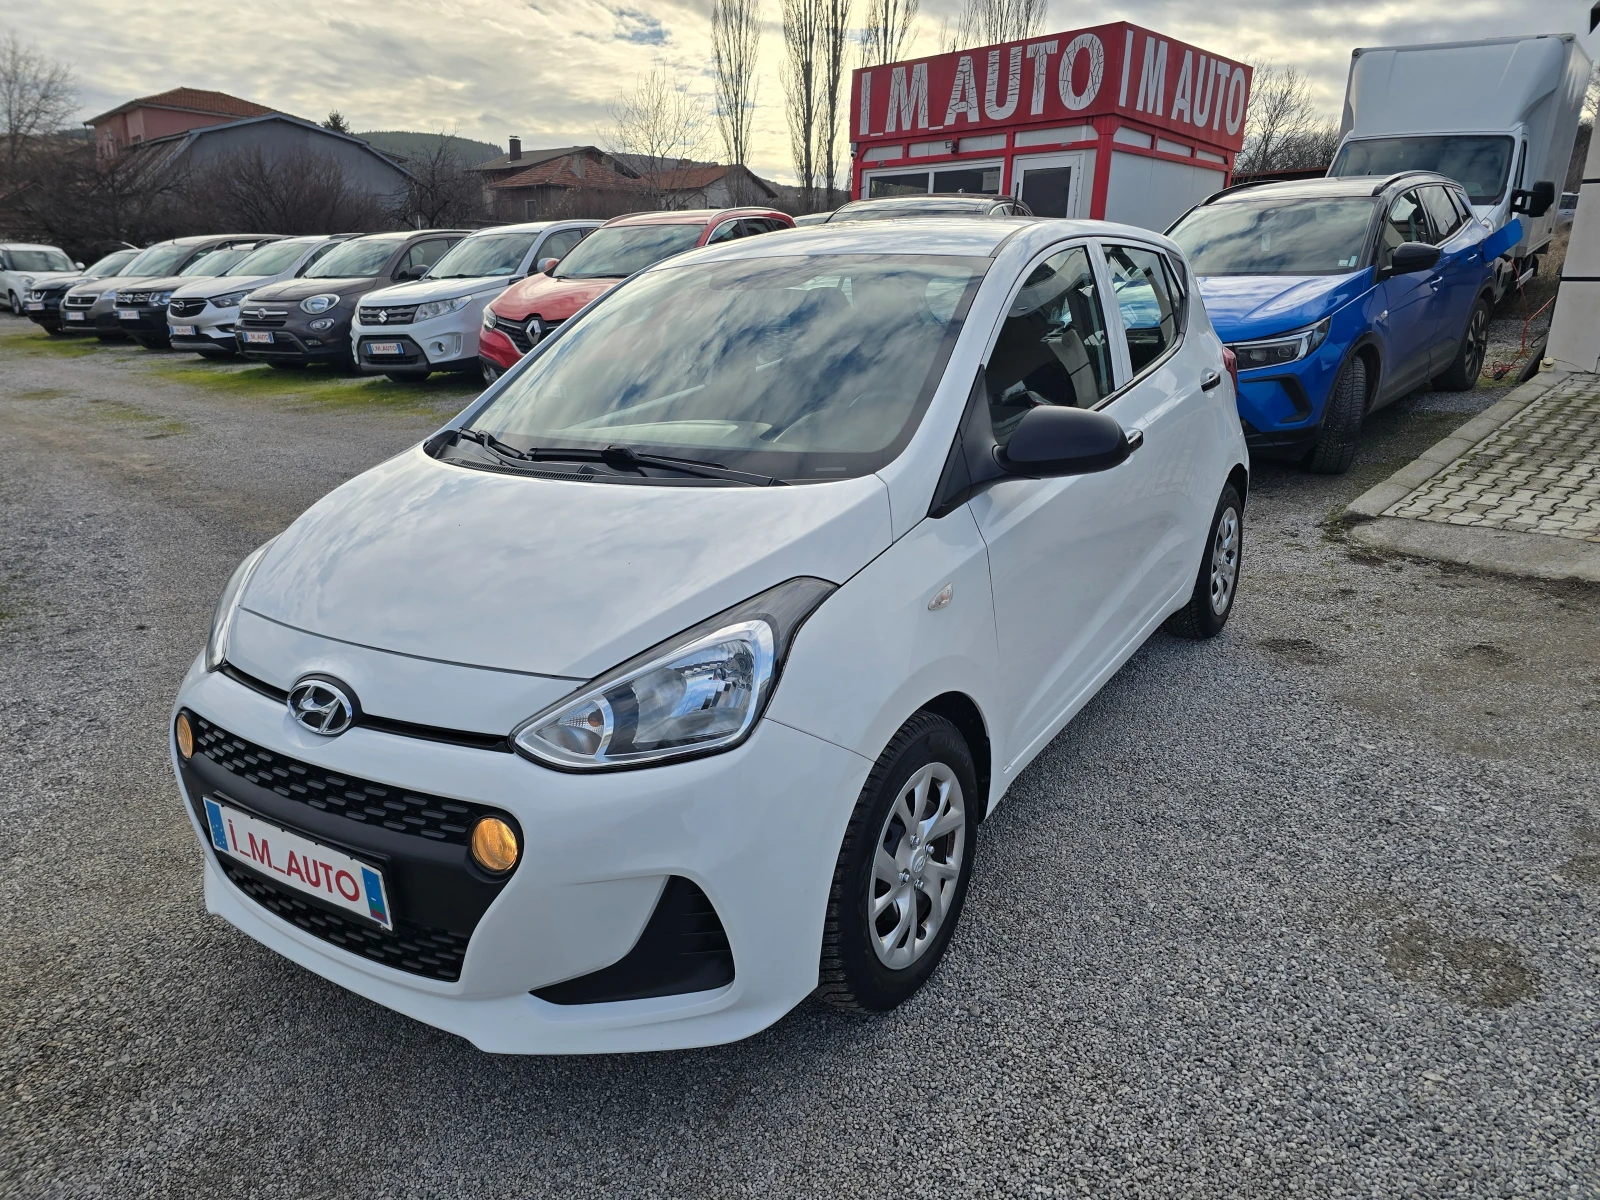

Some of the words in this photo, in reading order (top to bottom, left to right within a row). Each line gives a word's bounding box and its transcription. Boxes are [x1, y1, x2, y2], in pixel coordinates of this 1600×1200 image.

[1118, 29, 1134, 107] I
[1136, 36, 1168, 116] M
[1170, 50, 1246, 135] AUTO
